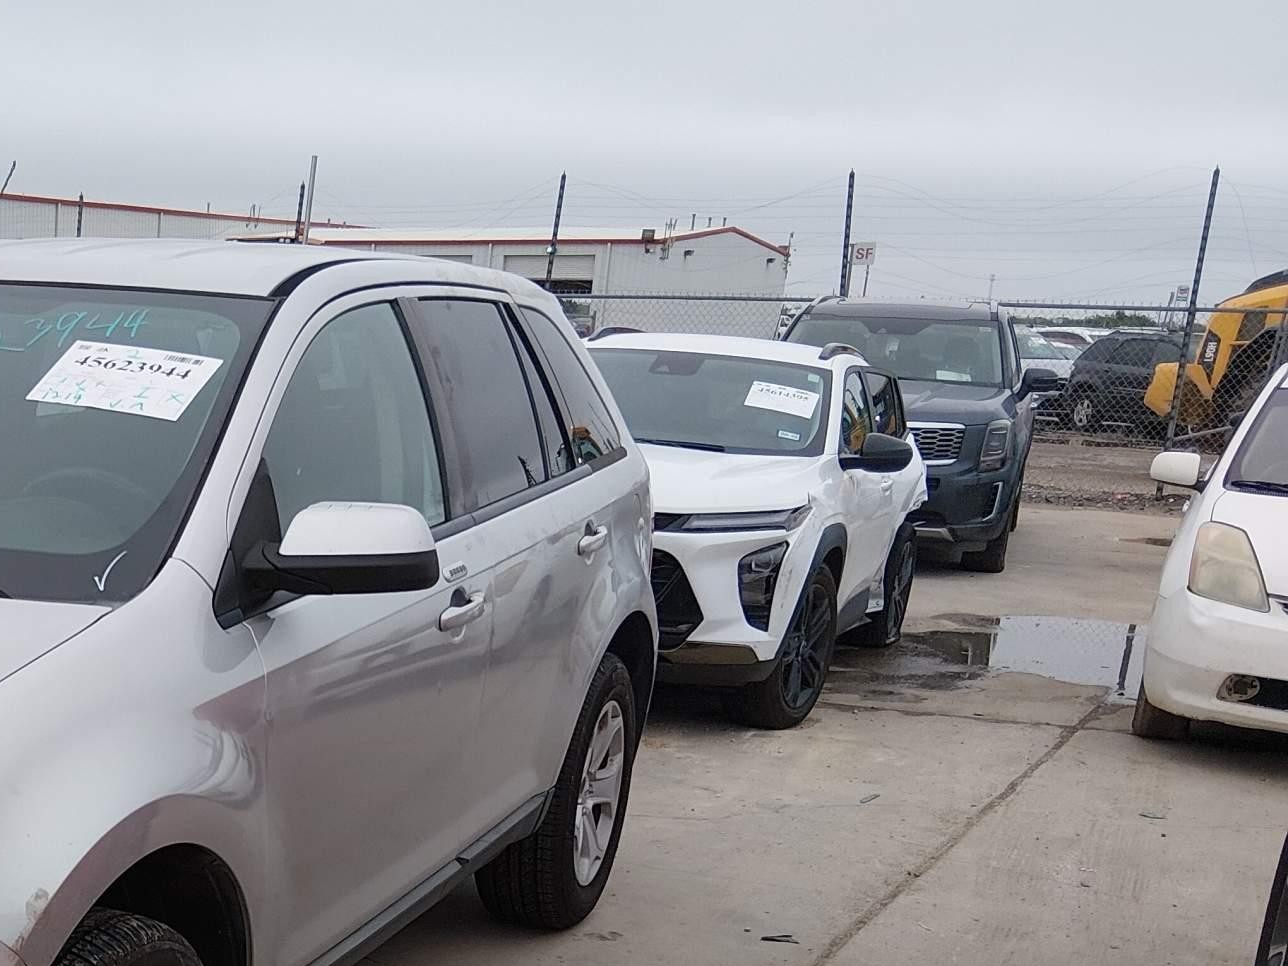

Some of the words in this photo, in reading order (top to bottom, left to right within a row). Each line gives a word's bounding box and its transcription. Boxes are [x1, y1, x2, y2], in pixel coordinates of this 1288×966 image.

[855, 247, 874, 260] SF
[1204, 341, 1218, 362] L90H
[74, 354, 192, 380] 45623944
